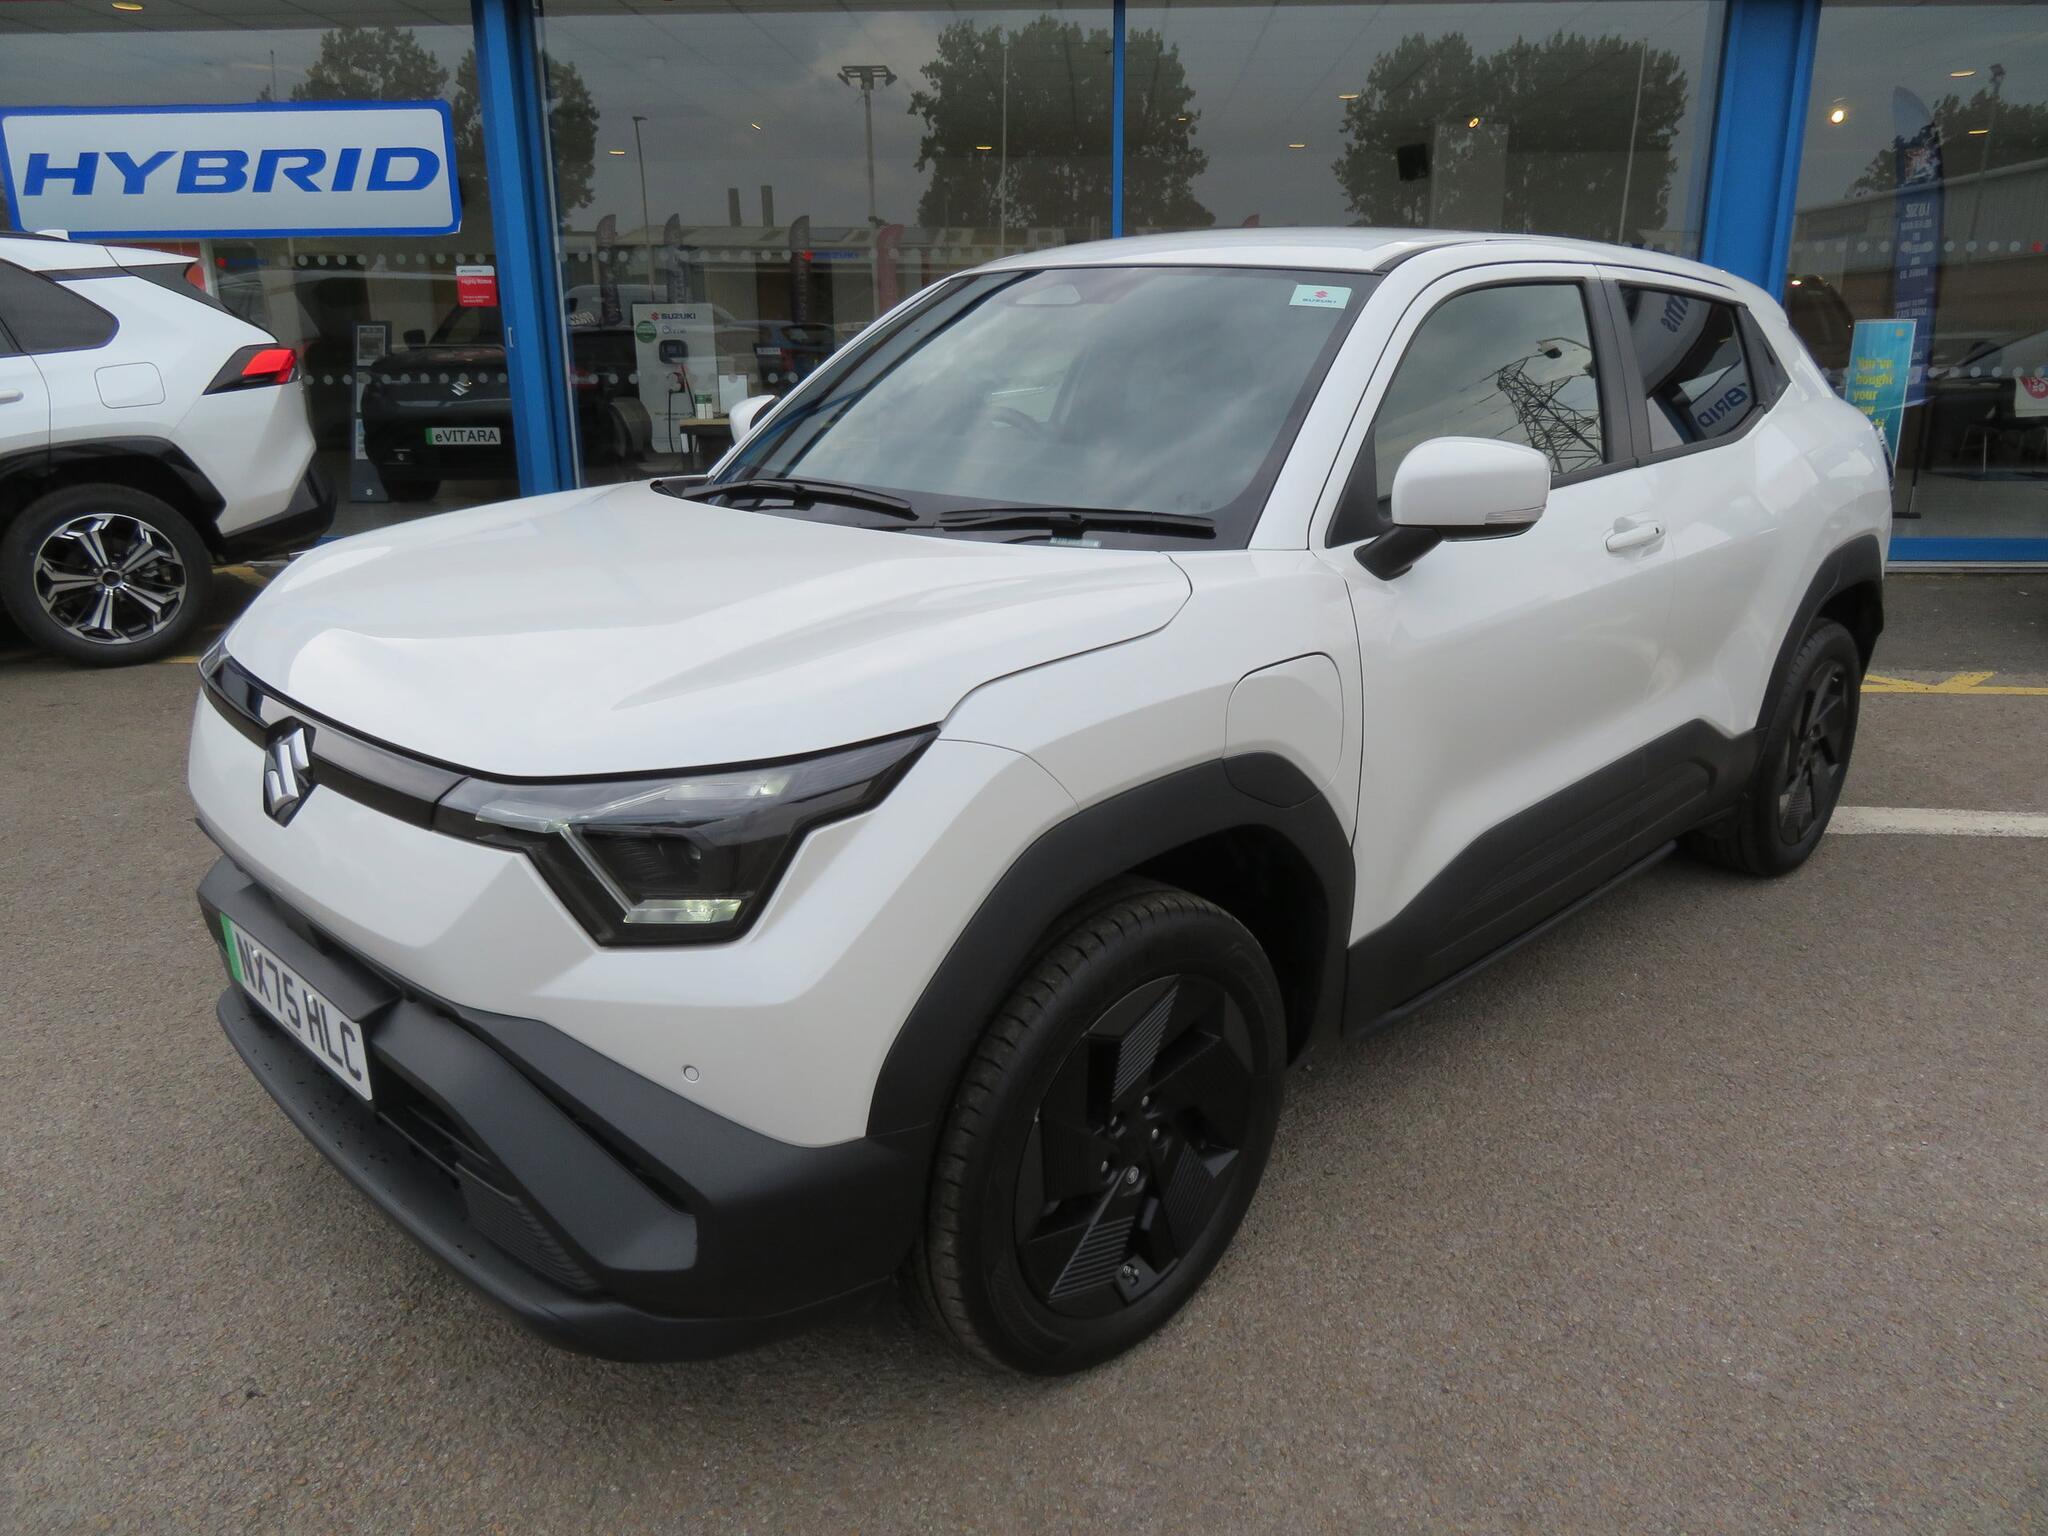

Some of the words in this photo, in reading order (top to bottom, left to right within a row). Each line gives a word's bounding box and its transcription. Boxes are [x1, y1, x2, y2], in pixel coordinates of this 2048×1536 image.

[23, 147, 440, 196] HYBRID
[661, 312, 696, 320] SUZUKI
[1856, 372, 1895, 388] bought
[1853, 391, 1878, 402] your
[435, 430, 497, 442] eVITARA
[236, 931, 302, 1029] NX75
[302, 988, 362, 1082] HLC
